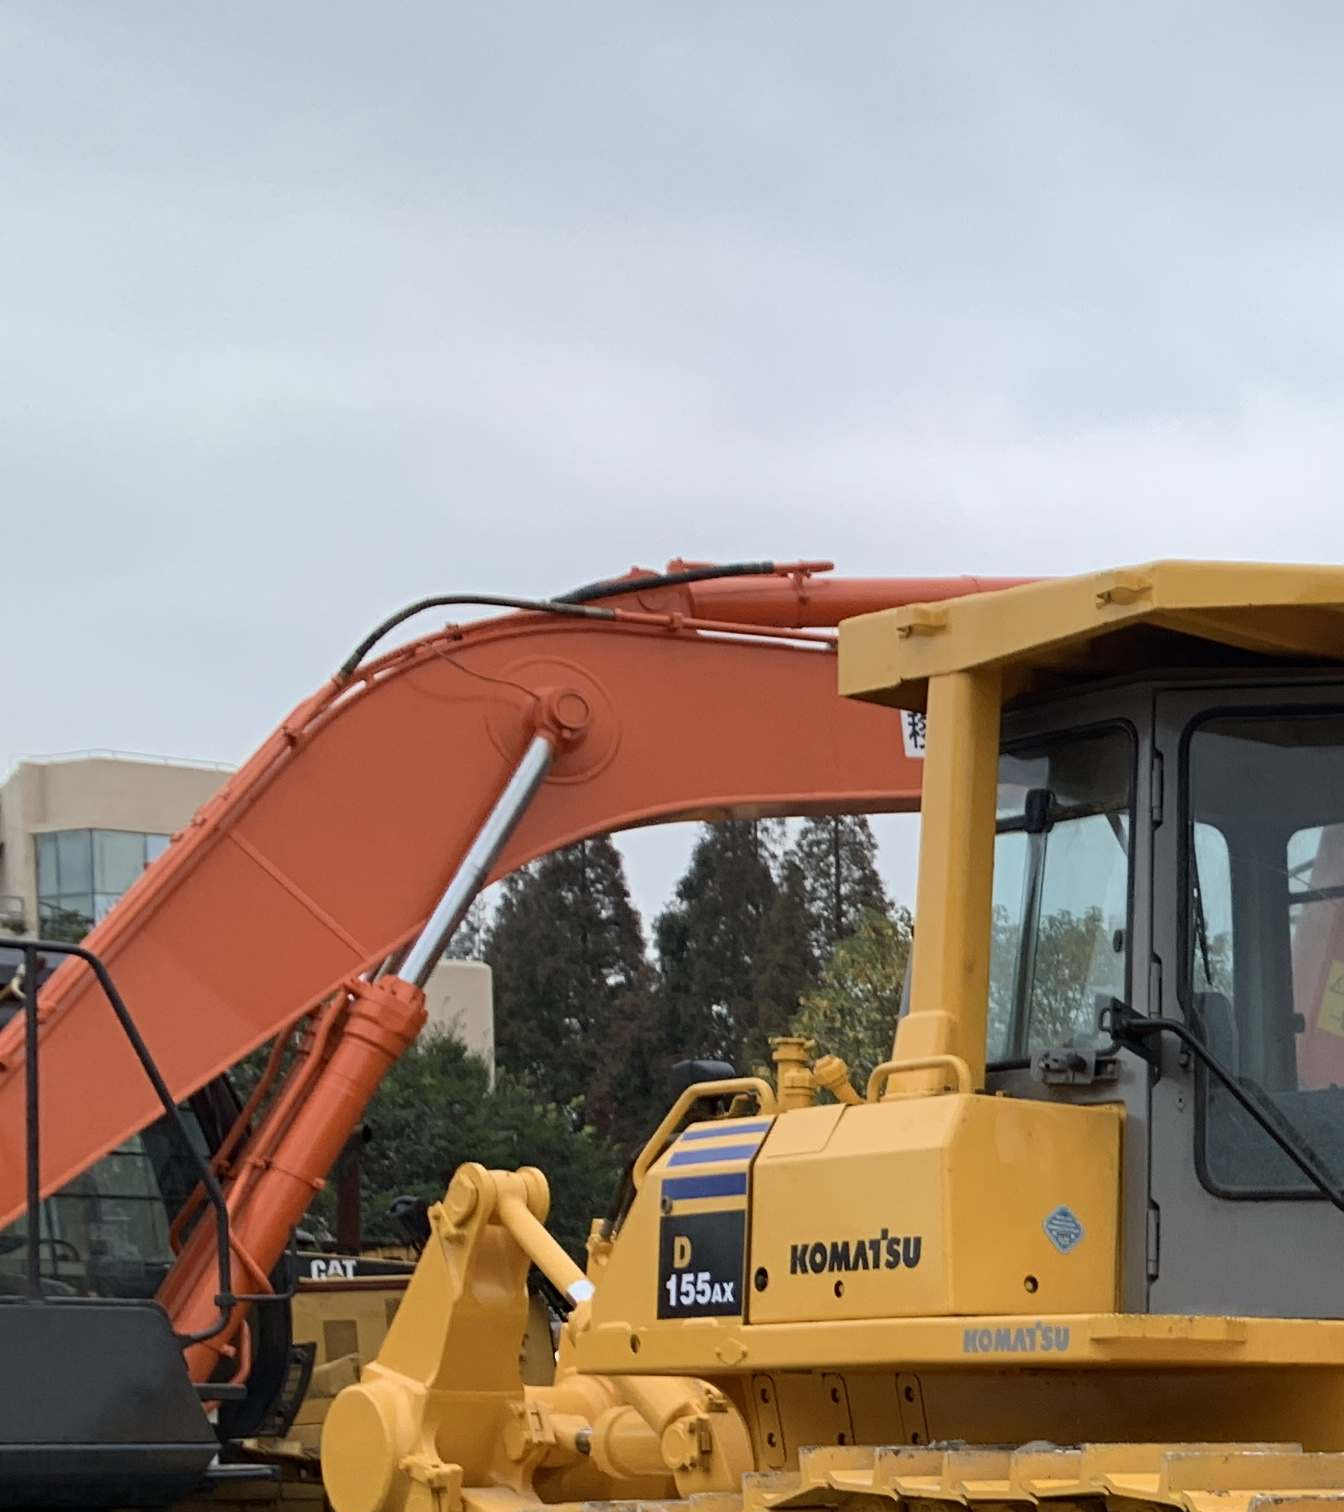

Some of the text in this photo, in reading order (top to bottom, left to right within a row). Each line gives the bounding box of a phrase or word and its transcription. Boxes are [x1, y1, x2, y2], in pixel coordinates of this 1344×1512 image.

[673, 1235, 692, 1269] D
[790, 1228, 922, 1274] KOMATSU
[310, 1259, 357, 1281] CAT
[666, 1271, 735, 1307] 155AX
[963, 1320, 1070, 1353] KOMATSU
